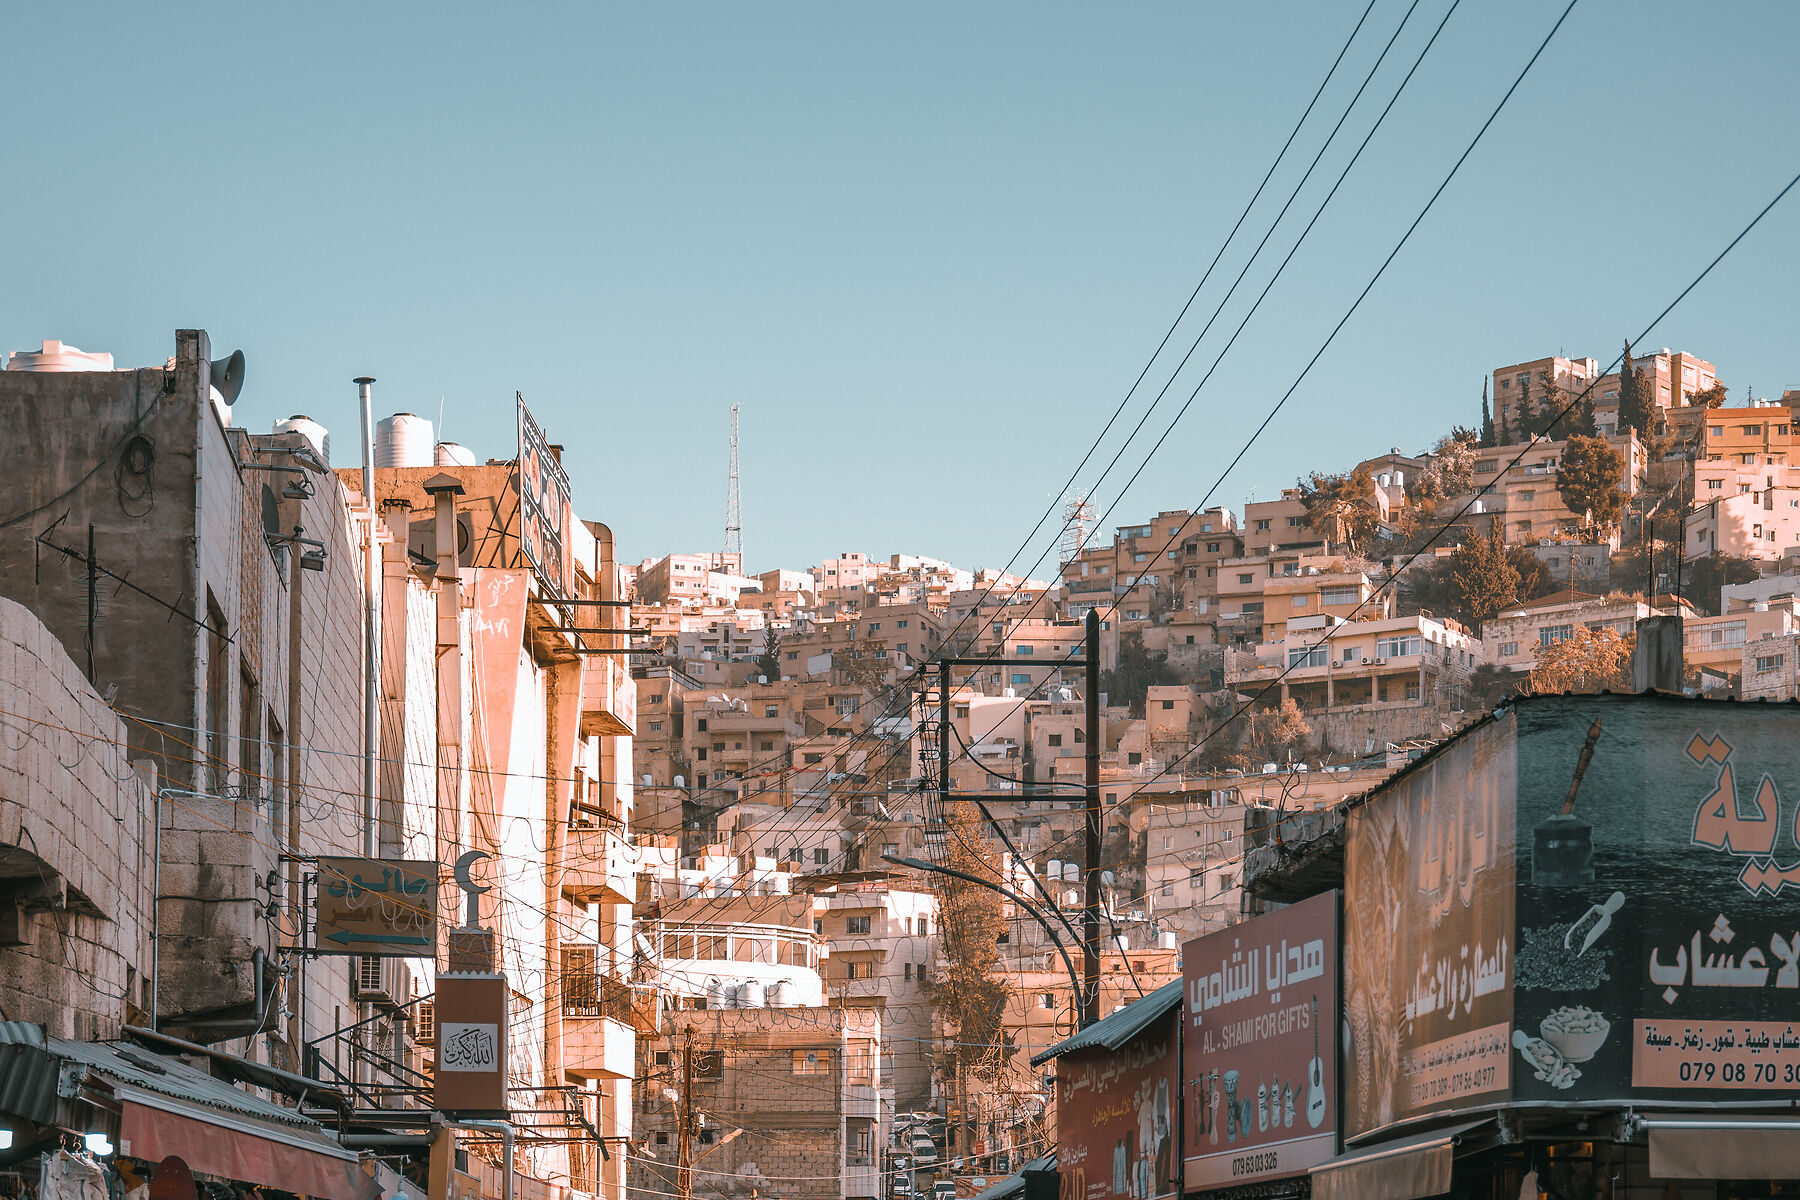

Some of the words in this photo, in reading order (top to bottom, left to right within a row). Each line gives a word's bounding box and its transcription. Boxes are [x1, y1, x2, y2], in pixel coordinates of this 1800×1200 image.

[328, 868, 429, 898] صالون
[331, 906, 374, 927] مصر
[1190, 938, 1259, 1027] الشامي
[1265, 939, 1324, 1004] هدايا
[1460, 934, 1508, 1015] للعطارة
[1203, 1031, 1216, 1055] AL
[1222, 1016, 1253, 1050] SHAMI
[1255, 1011, 1276, 1041] FOR
[1278, 1003, 1310, 1037] GIFTS
[1645, 1026, 1672, 1052] صبغة
[1680, 1028, 1703, 1051] زعتر
[1712, 1028, 1735, 1052] تمور
[1745, 1027, 1769, 1053] طبية
[1680, 1061, 1715, 1081] 079
[1722, 1062, 1745, 1082] 08
[1754, 1063, 1776, 1083] 70
[1232, 1157, 1245, 1177] 079
[1246, 1157, 1254, 1173] 63
[1255, 1155, 1264, 1172] 03
[1264, 1152, 1277, 1170] 326
